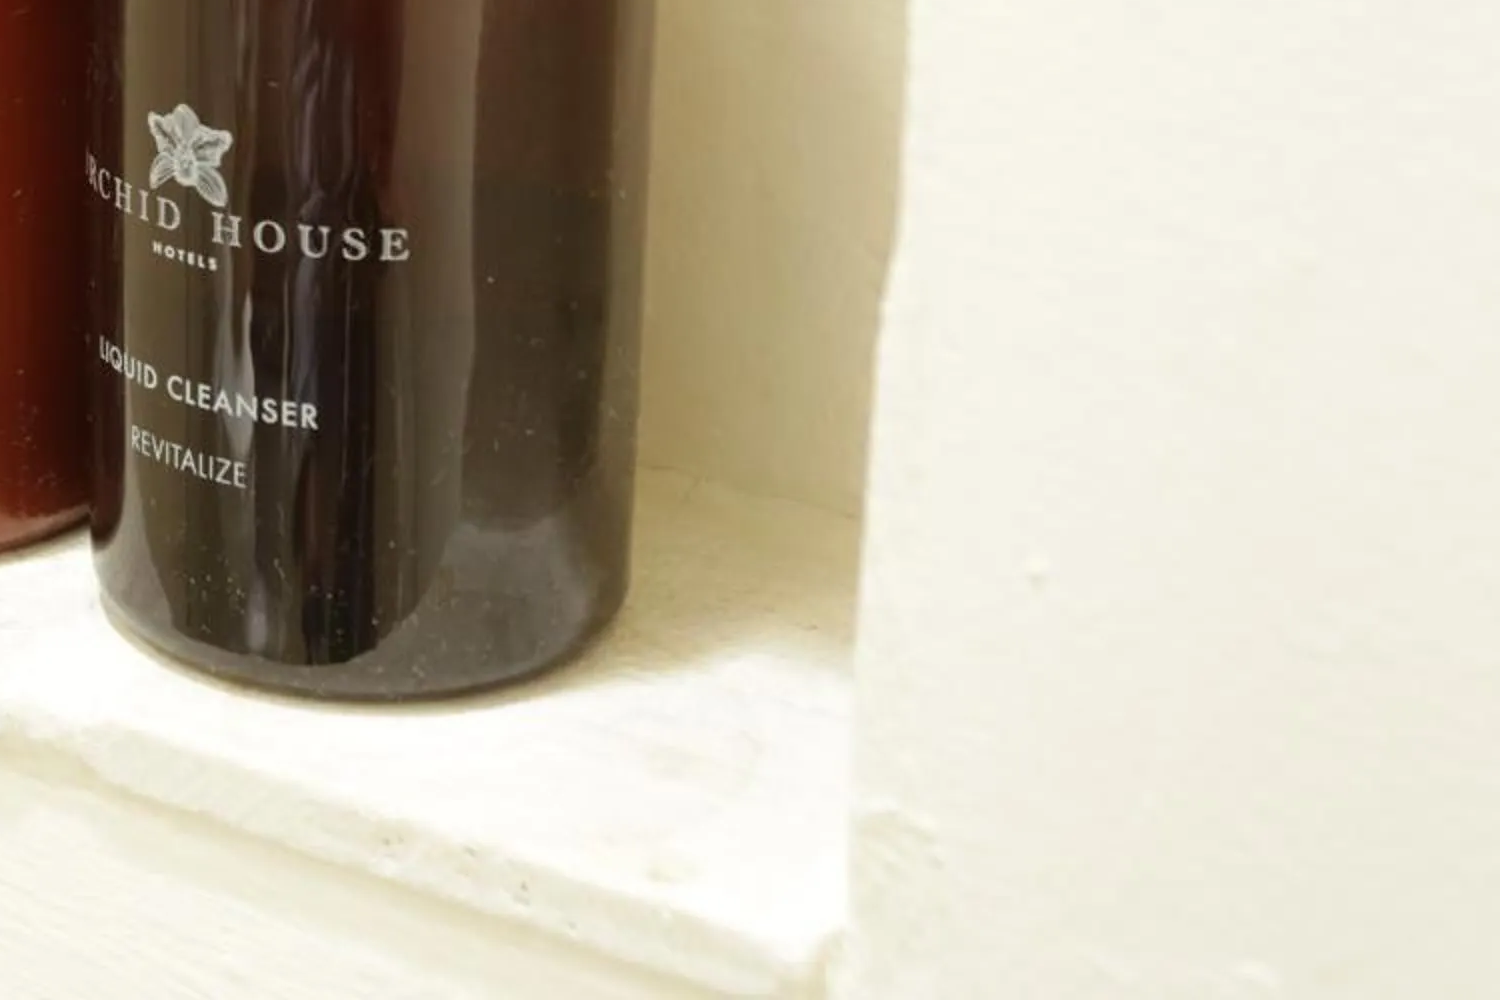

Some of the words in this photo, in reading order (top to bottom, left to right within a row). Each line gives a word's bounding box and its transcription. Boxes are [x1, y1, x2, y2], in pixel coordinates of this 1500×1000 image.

[85, 150, 182, 231] RCHID
[211, 210, 411, 262] HOUSE
[152, 240, 218, 271] HOTELS
[99, 335, 158, 389] LIQUID
[167, 375, 320, 430] CLEANSER
[131, 424, 248, 489] REVITALIZE
